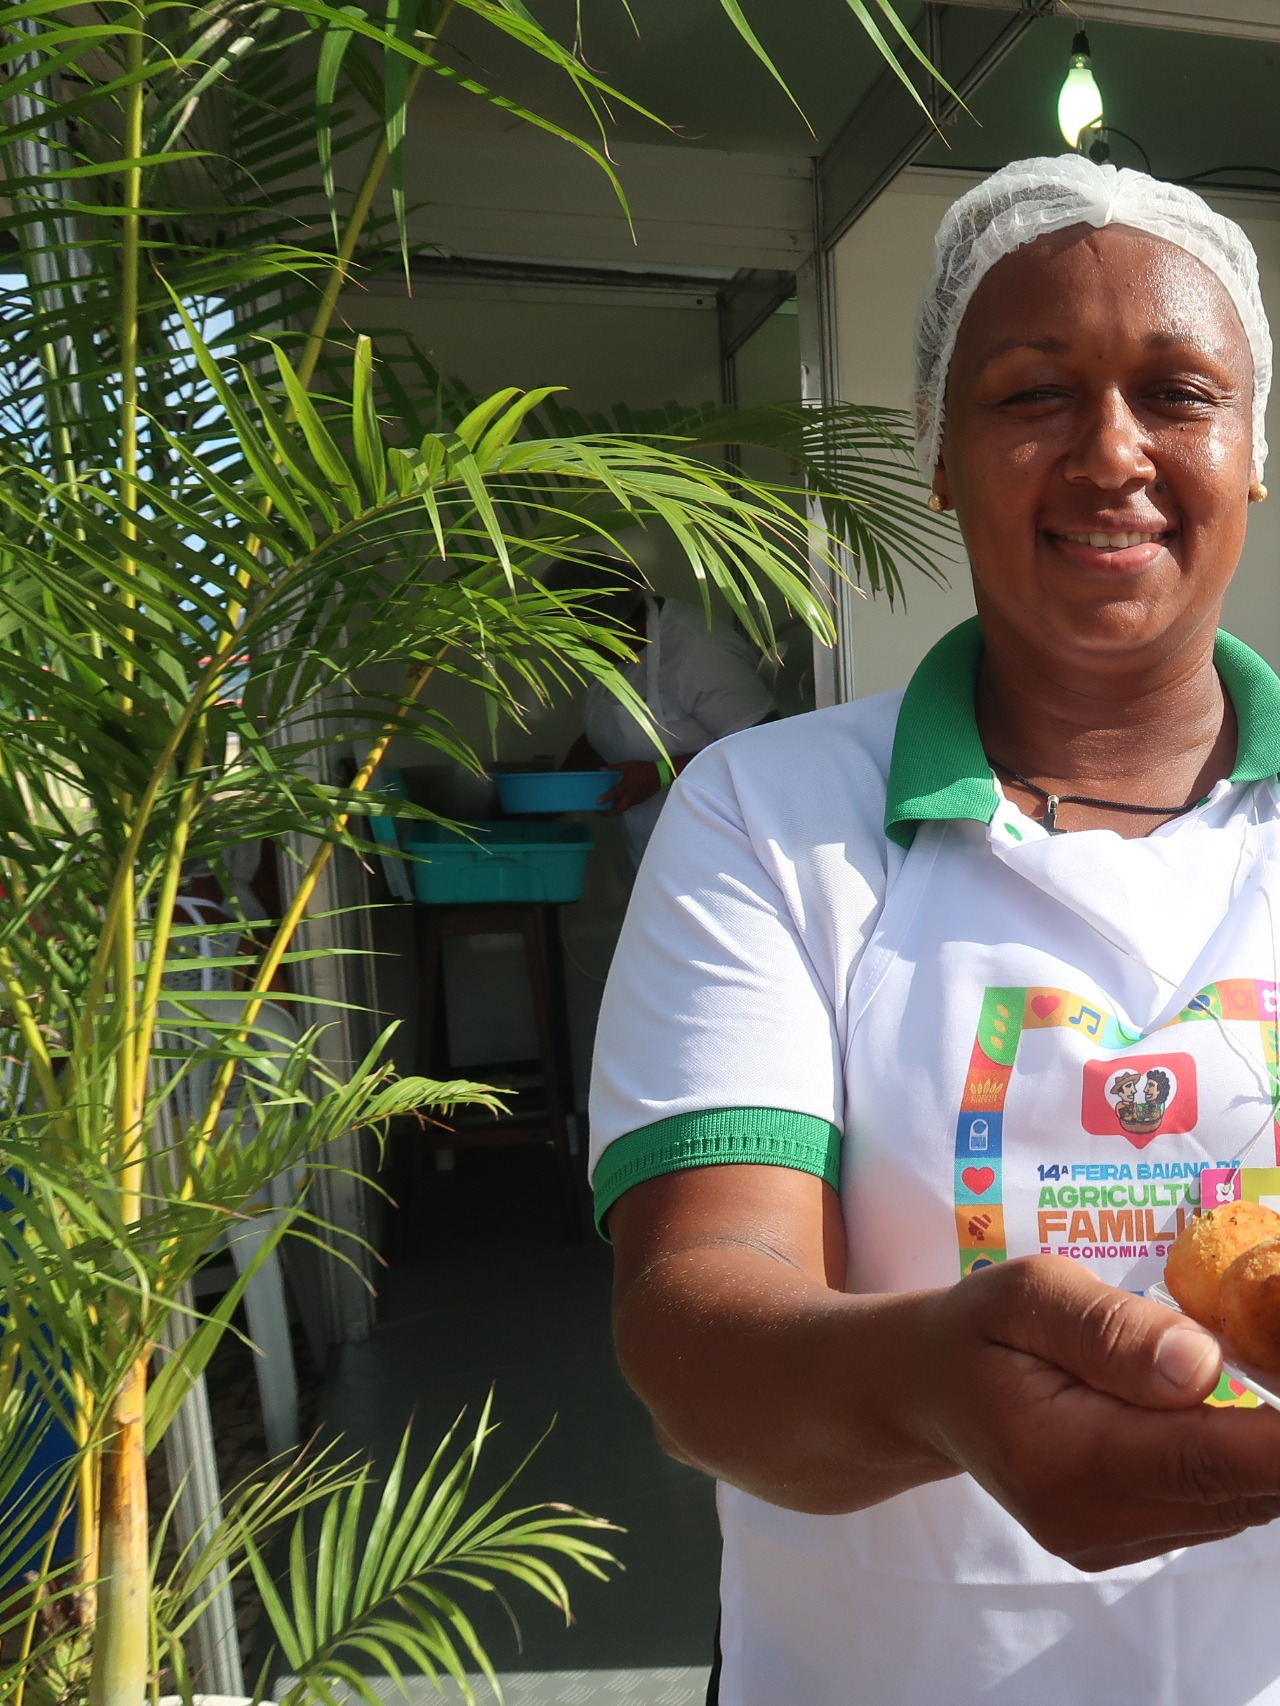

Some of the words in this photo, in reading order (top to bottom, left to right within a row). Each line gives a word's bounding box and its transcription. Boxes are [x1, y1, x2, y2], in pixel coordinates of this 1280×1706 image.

[1071, 1163, 1133, 1181] FEIRA
[1037, 1184, 1201, 1208] AGRICULTU
[1058, 1244, 1149, 1259] ECONOMIA
